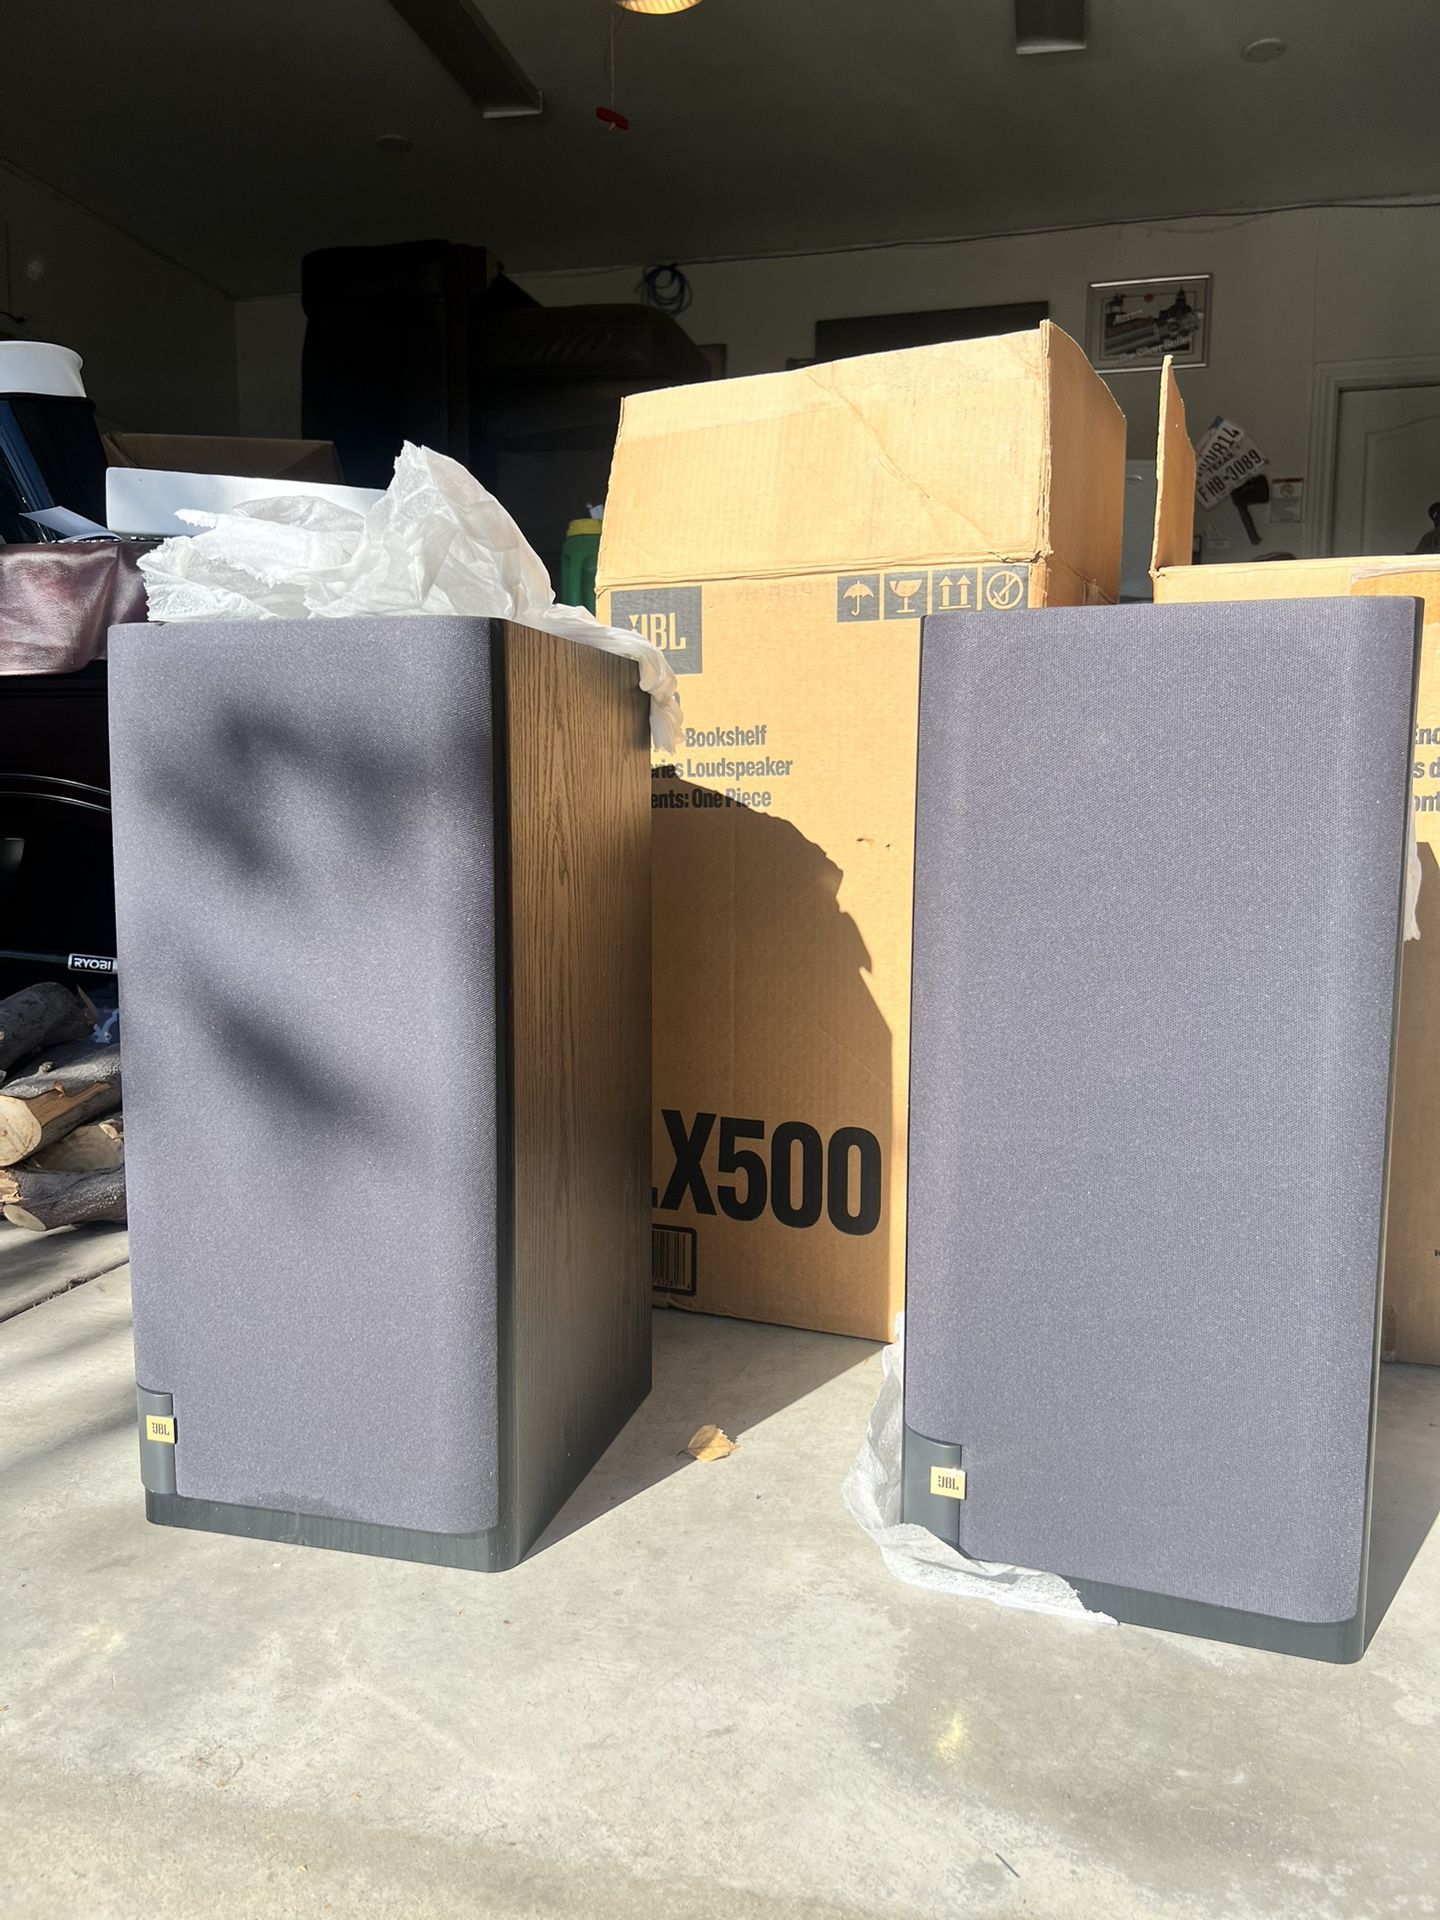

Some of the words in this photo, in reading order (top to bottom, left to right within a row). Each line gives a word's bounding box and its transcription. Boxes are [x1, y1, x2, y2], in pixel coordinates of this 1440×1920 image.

[685, 724, 767, 748] Bookshelf
[686, 756, 794, 781] Loudspeaker
[691, 788, 723, 809] One
[725, 787, 772, 809] Piece
[73, 957, 112, 971] RYOBI
[652, 1109, 882, 1236] X500
[152, 1422, 170, 1436] JBL
[937, 1475, 960, 1491] JBL
